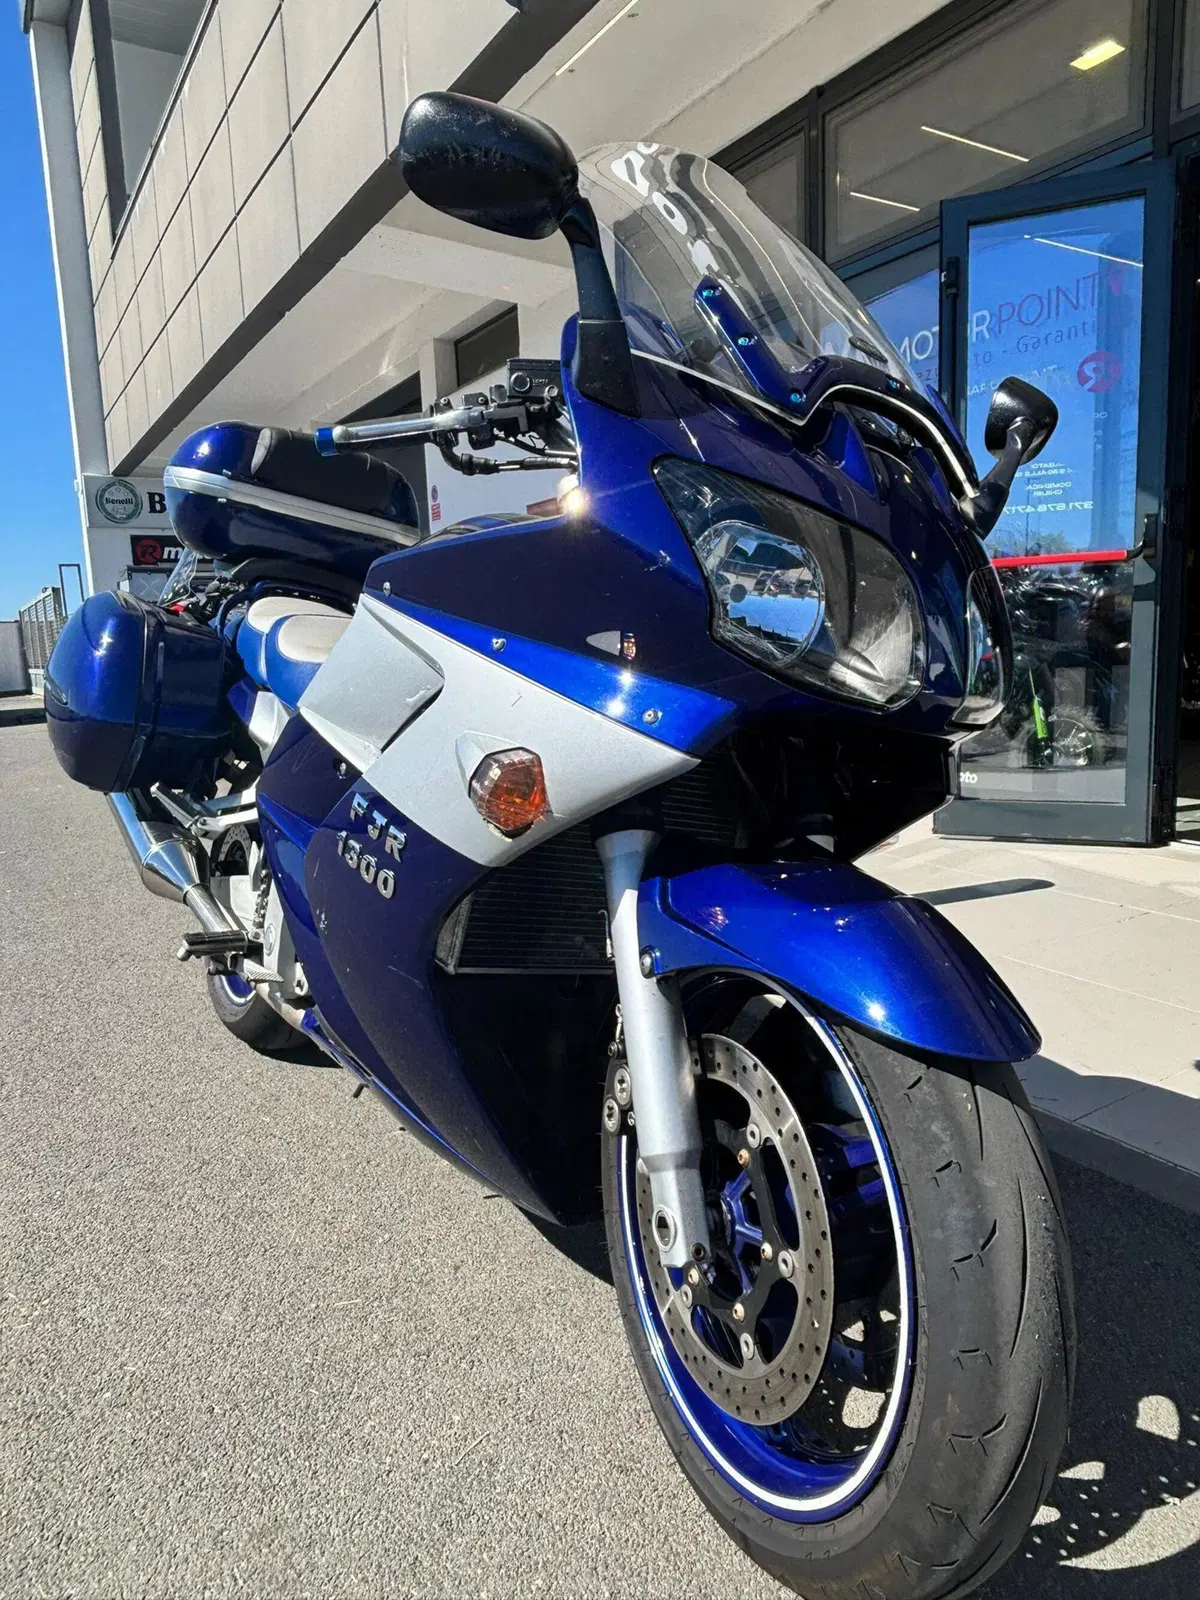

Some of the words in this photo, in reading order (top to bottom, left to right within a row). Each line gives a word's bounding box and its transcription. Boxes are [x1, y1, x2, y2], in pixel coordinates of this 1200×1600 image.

[105, 497, 134, 506] Benelli
[349, 792, 407, 864] FJR
[336, 830, 396, 899] 1300
